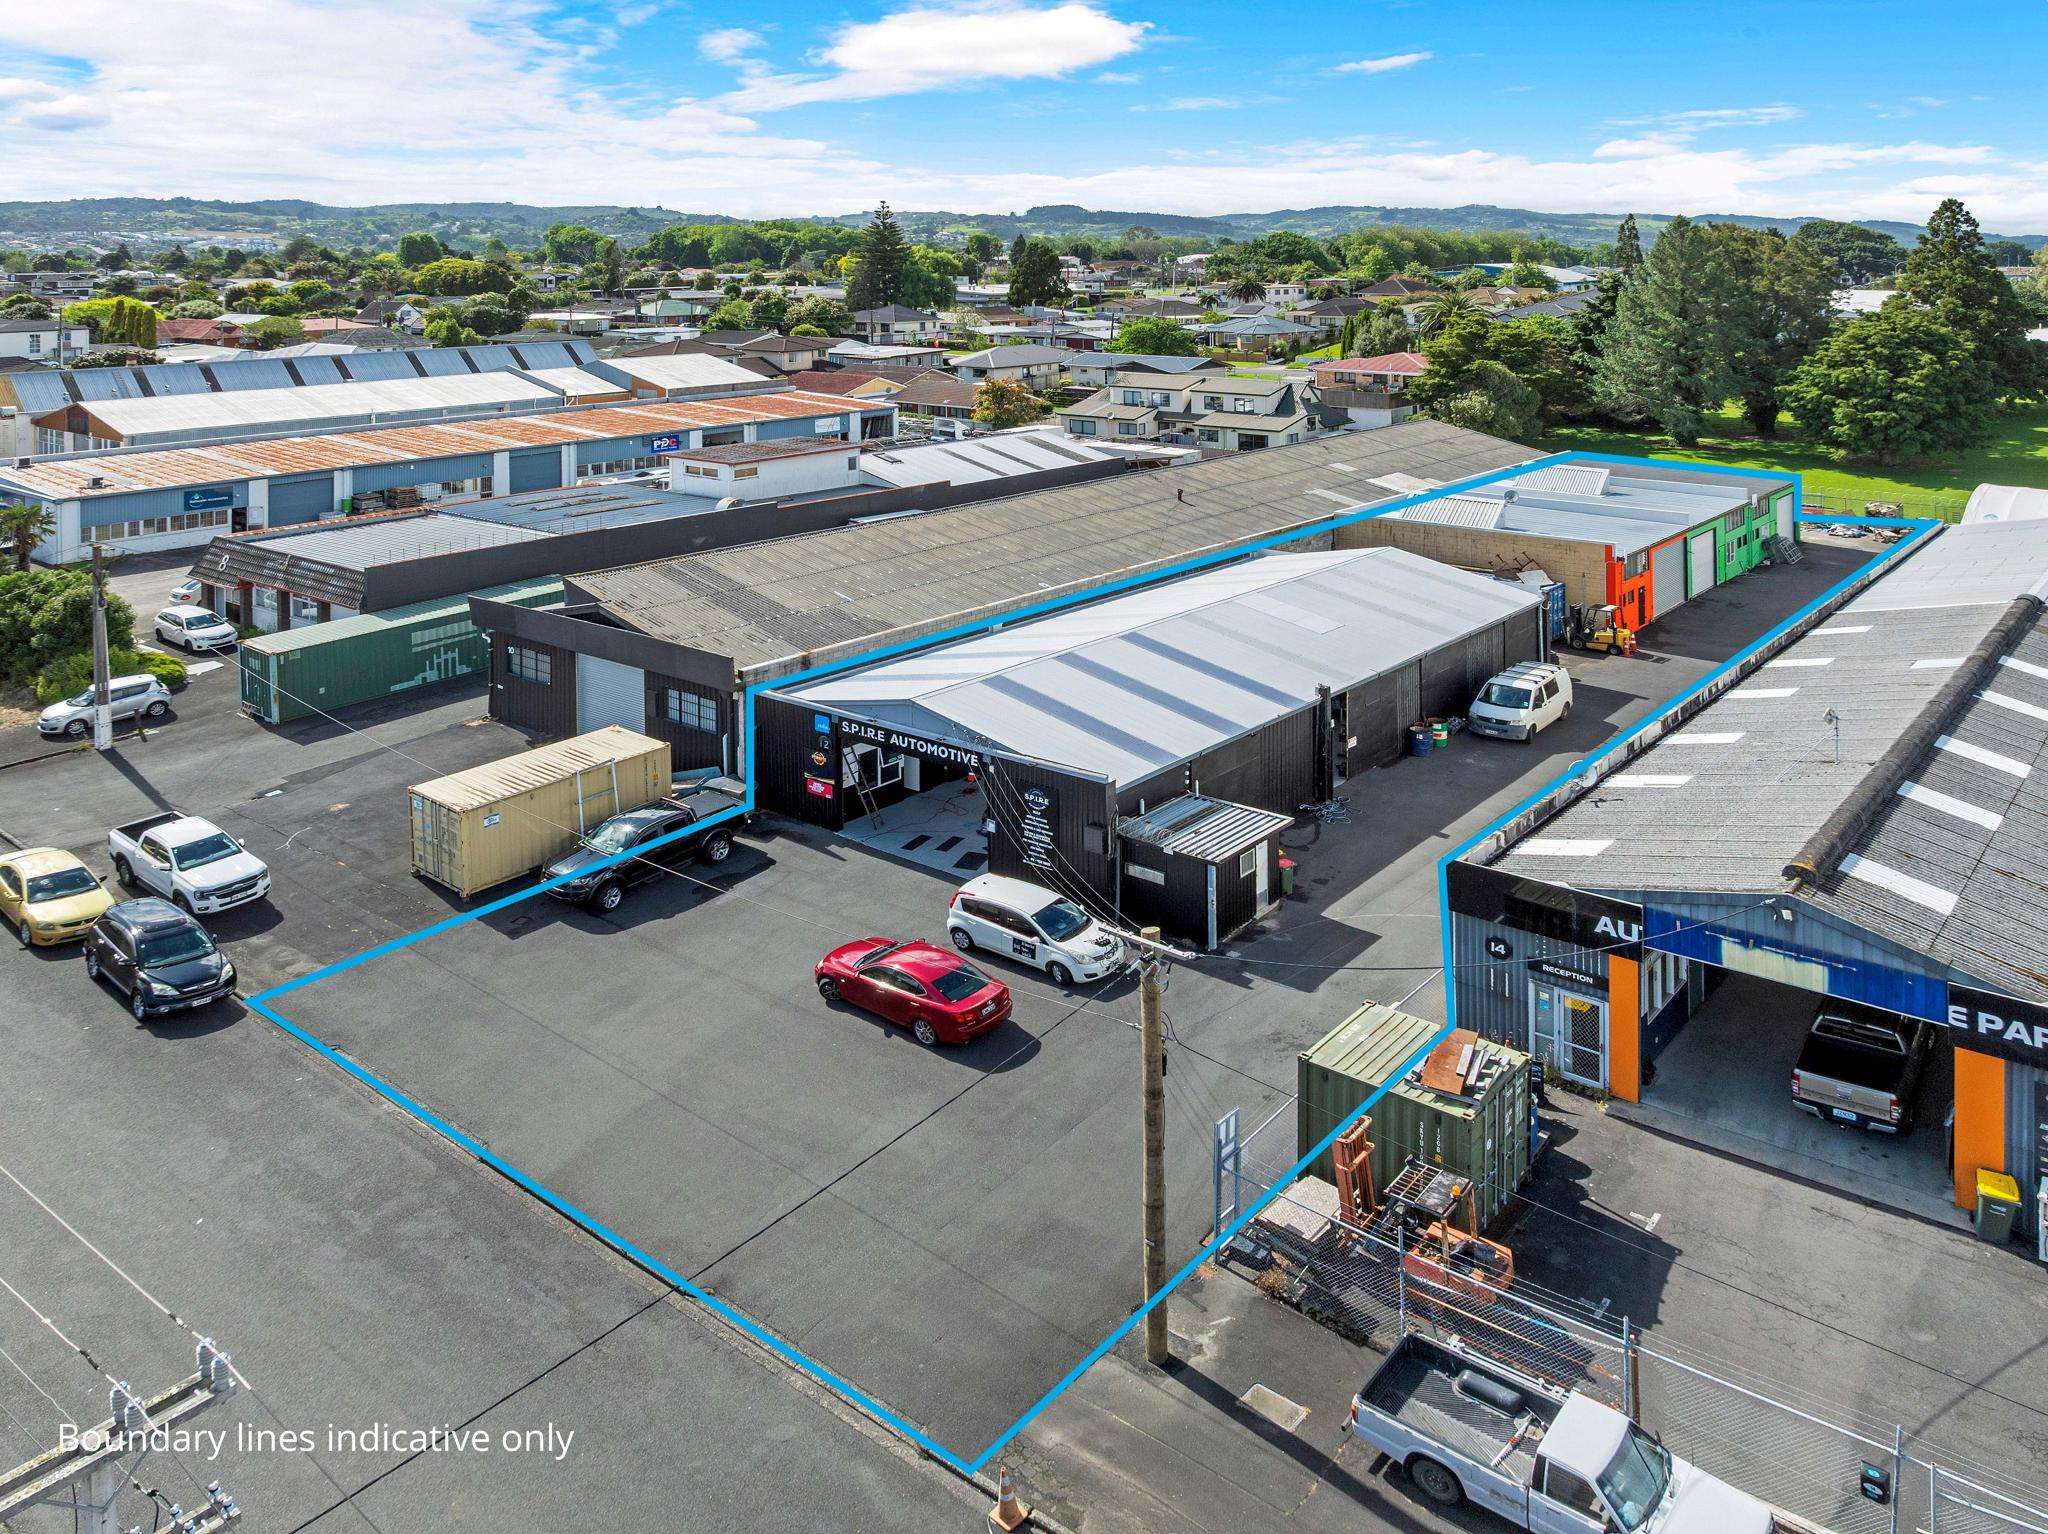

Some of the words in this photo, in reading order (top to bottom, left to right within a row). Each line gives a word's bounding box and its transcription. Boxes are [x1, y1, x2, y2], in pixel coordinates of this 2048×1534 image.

[219, 554, 230, 571] 8
[842, 721, 885, 742] S.P.I.R.E
[890, 733, 979, 767] AUTOMOTIVE
[1490, 941, 1506, 955] 14
[1542, 964, 1594, 985] RECEPTION
